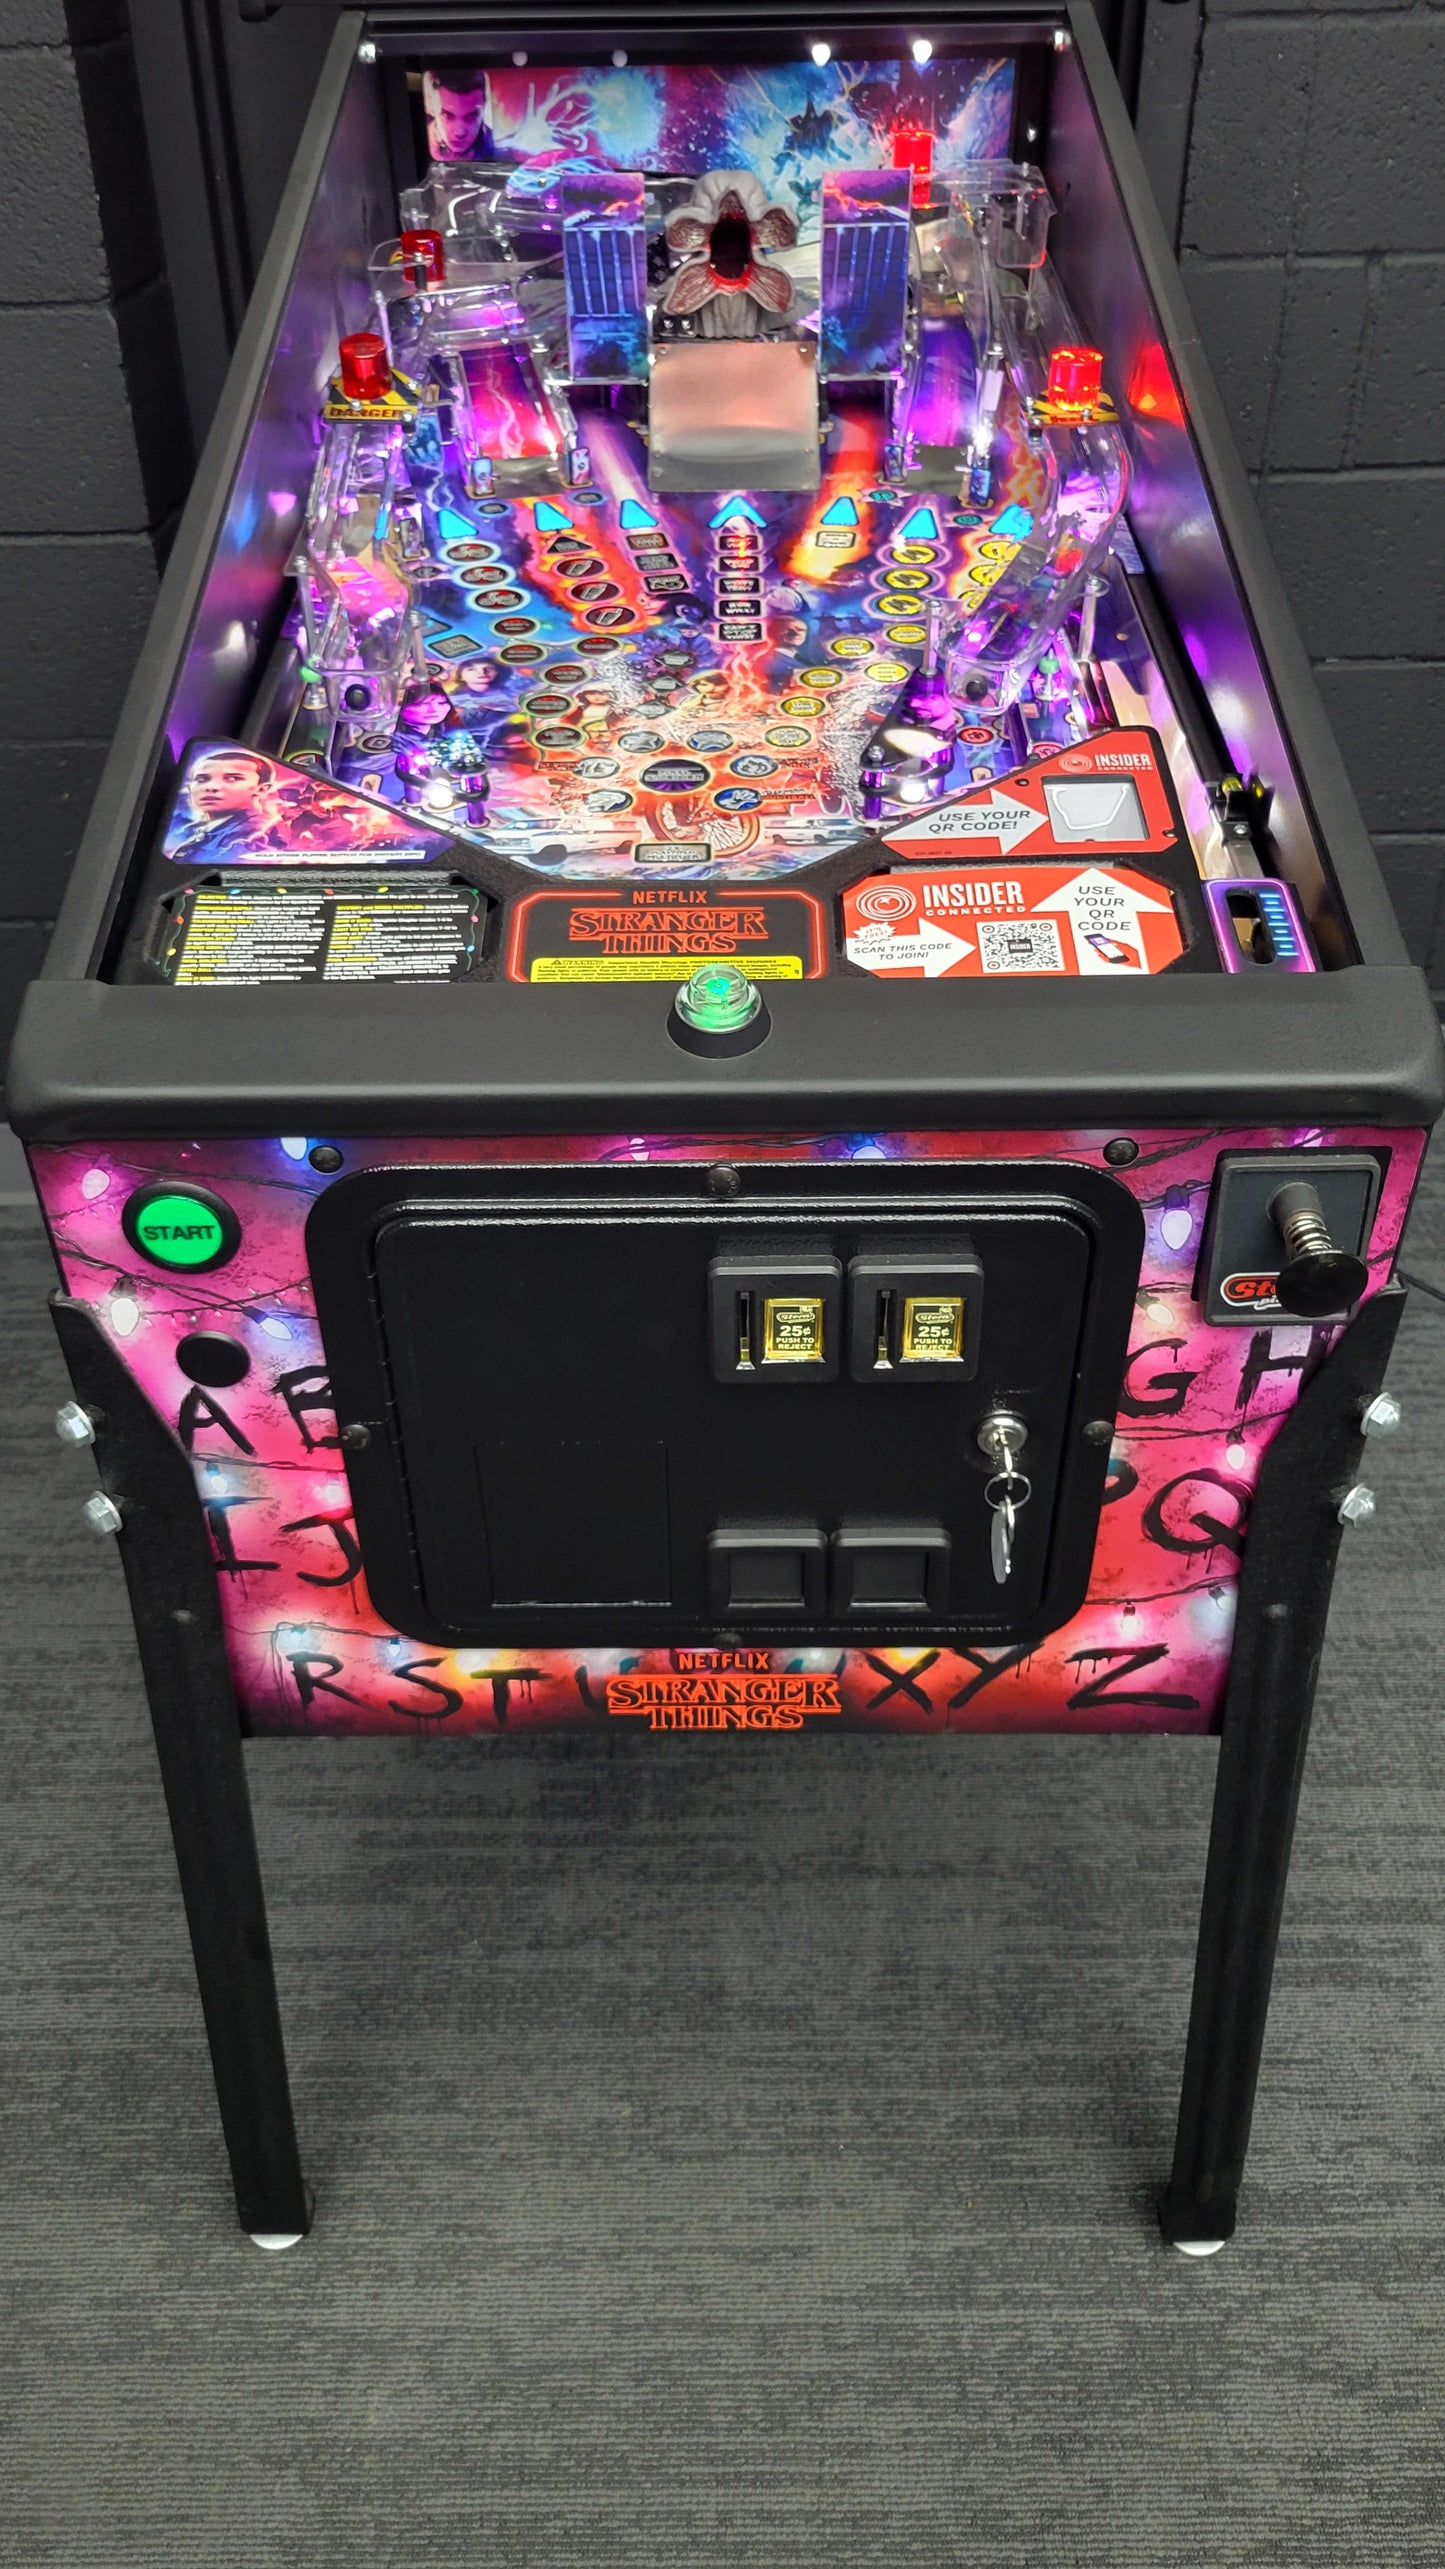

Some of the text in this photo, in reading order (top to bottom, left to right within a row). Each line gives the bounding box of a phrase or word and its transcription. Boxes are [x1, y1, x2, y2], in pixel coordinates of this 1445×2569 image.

[1094, 753, 1151, 767] INSIDER
[938, 810, 1031, 822] USE YOUR
[928, 821, 1018, 834] QR CODE!
[632, 890, 708, 904] NETFLIX
[922, 881, 1024, 908] INSIDER
[1078, 885, 1116, 895] USE
[1074, 897, 1125, 907] YOUR
[925, 906, 1026, 917] CONNECTED
[1088, 909, 1115, 920] QR
[568, 908, 768, 939] STRANGER
[1078, 921, 1132, 931] CODE
[602, 932, 737, 954] THINGS
[853, 946, 889, 954] SCAN
[890, 944, 916, 953] THIS
[898, 952, 929, 960] JOIN!
[143, 1224, 215, 1242] START
[779, 1325, 811, 1337] 25¢
[917, 1326, 950, 1338] 25¢
[1115, 1338, 1200, 1418] G
[179, 1385, 257, 1456] A
[1143, 1467, 1256, 1555] Q
[678, 1652, 770, 1670] NETFLIX
[865, 1650, 941, 1712] X
[1065, 1642, 1200, 1709] Z
[285, 1651, 374, 1707] R
[390, 1658, 464, 1719] S
[469, 1667, 552, 1724] T
[606, 1674, 842, 1713] STRANGER
[647, 1704, 804, 1730] THINGS
